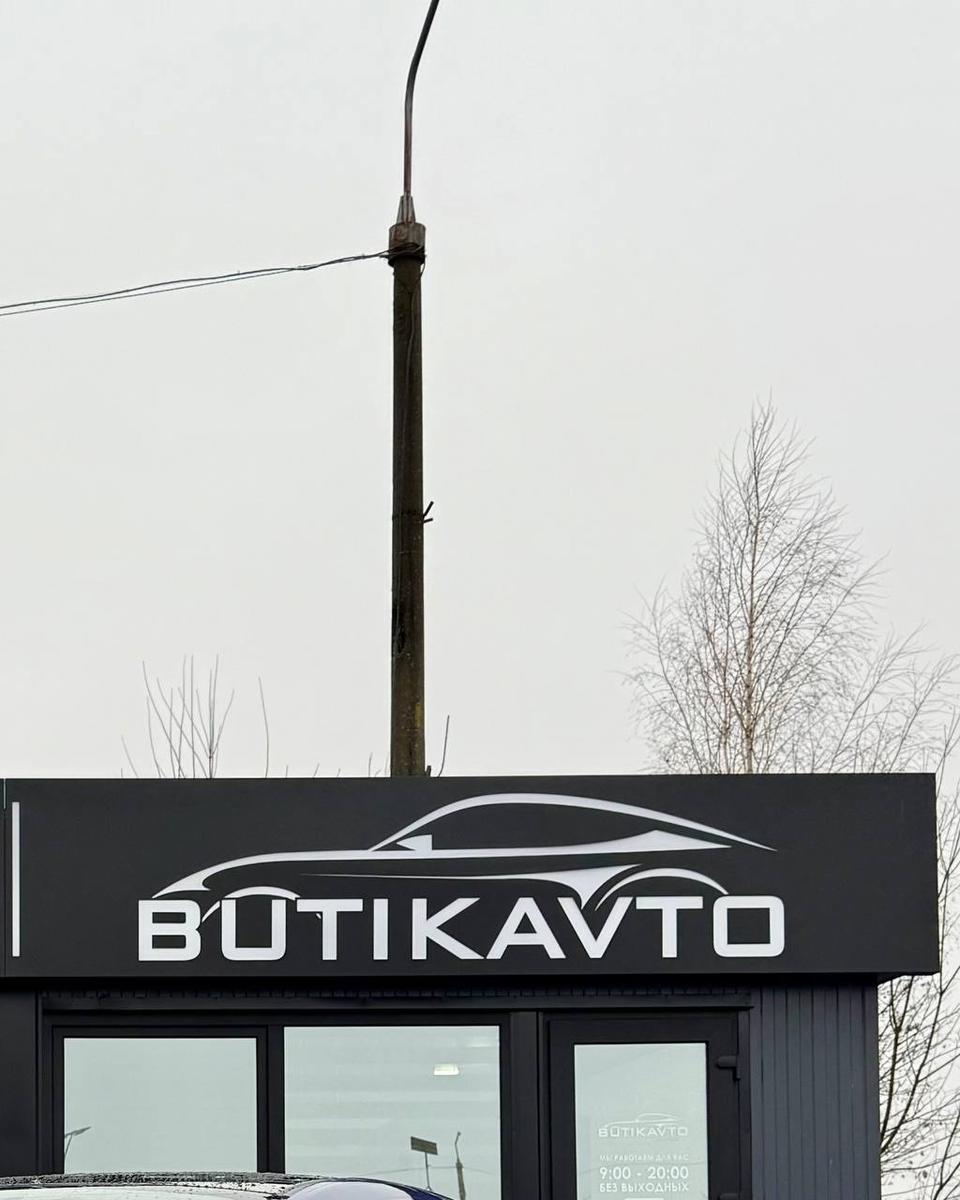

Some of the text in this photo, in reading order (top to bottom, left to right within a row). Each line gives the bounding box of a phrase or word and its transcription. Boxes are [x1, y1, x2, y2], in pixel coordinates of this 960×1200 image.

[139, 895, 785, 961] BUTIKAVTO
[598, 1127, 688, 1137] BUTIKAVTO
[600, 1166, 631, 1180] 9:00
[647, 1166, 689, 1180] 20:00
[600, 1182, 689, 1193] БЕЗ ВЫХОДНЫХ
